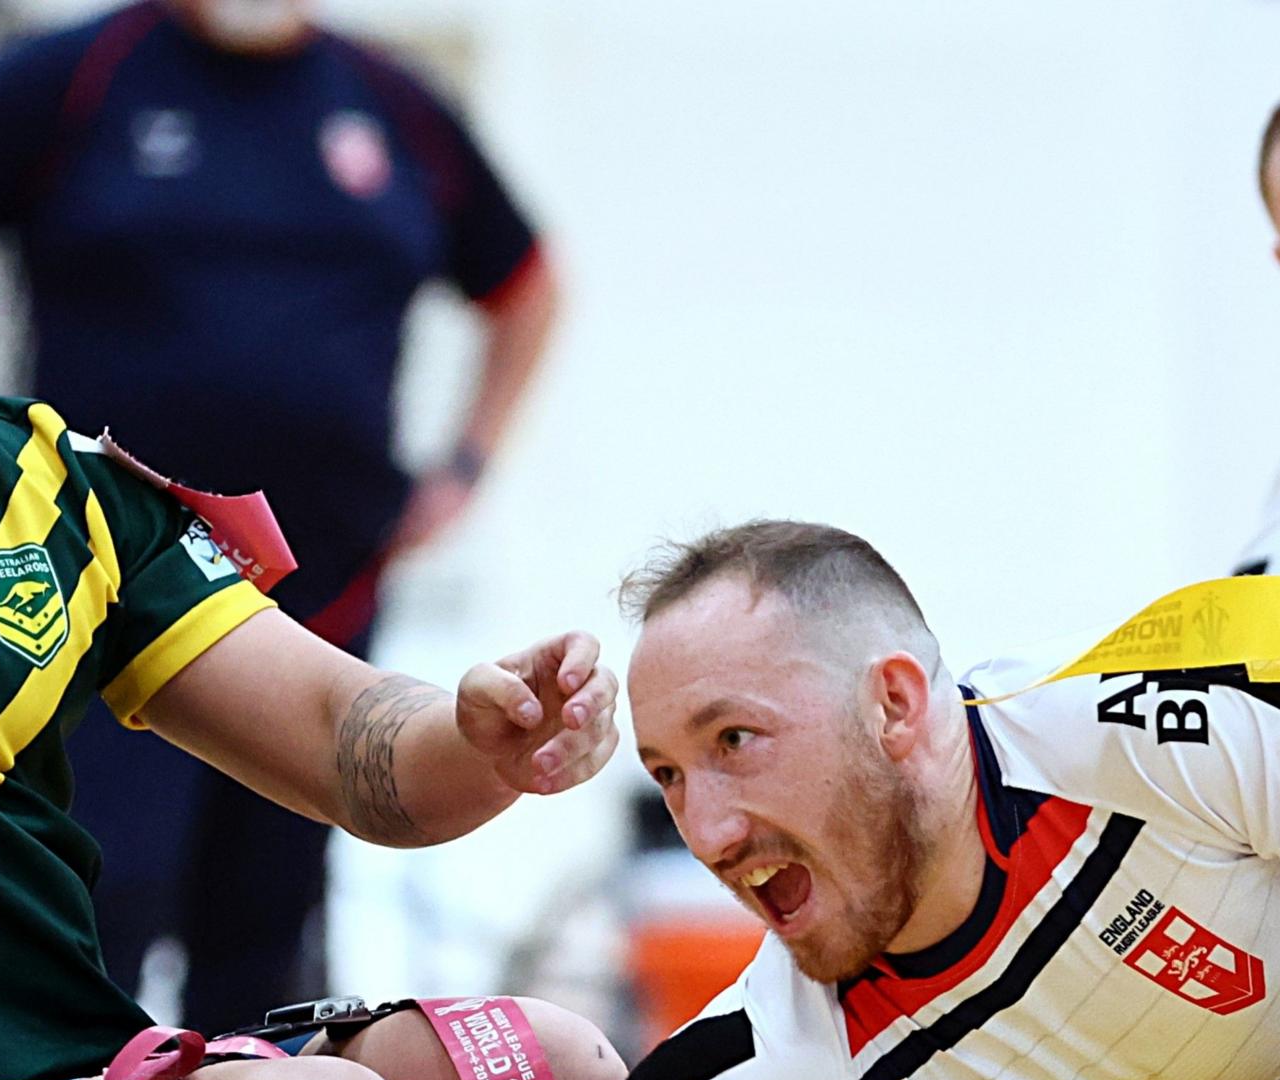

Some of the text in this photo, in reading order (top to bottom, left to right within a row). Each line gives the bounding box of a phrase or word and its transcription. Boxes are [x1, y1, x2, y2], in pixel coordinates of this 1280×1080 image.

[1099, 889, 1155, 947] ENGLAND
[1113, 900, 1166, 956] RUGBY LEAGUE
[464, 1011, 513, 1075] WORLD
